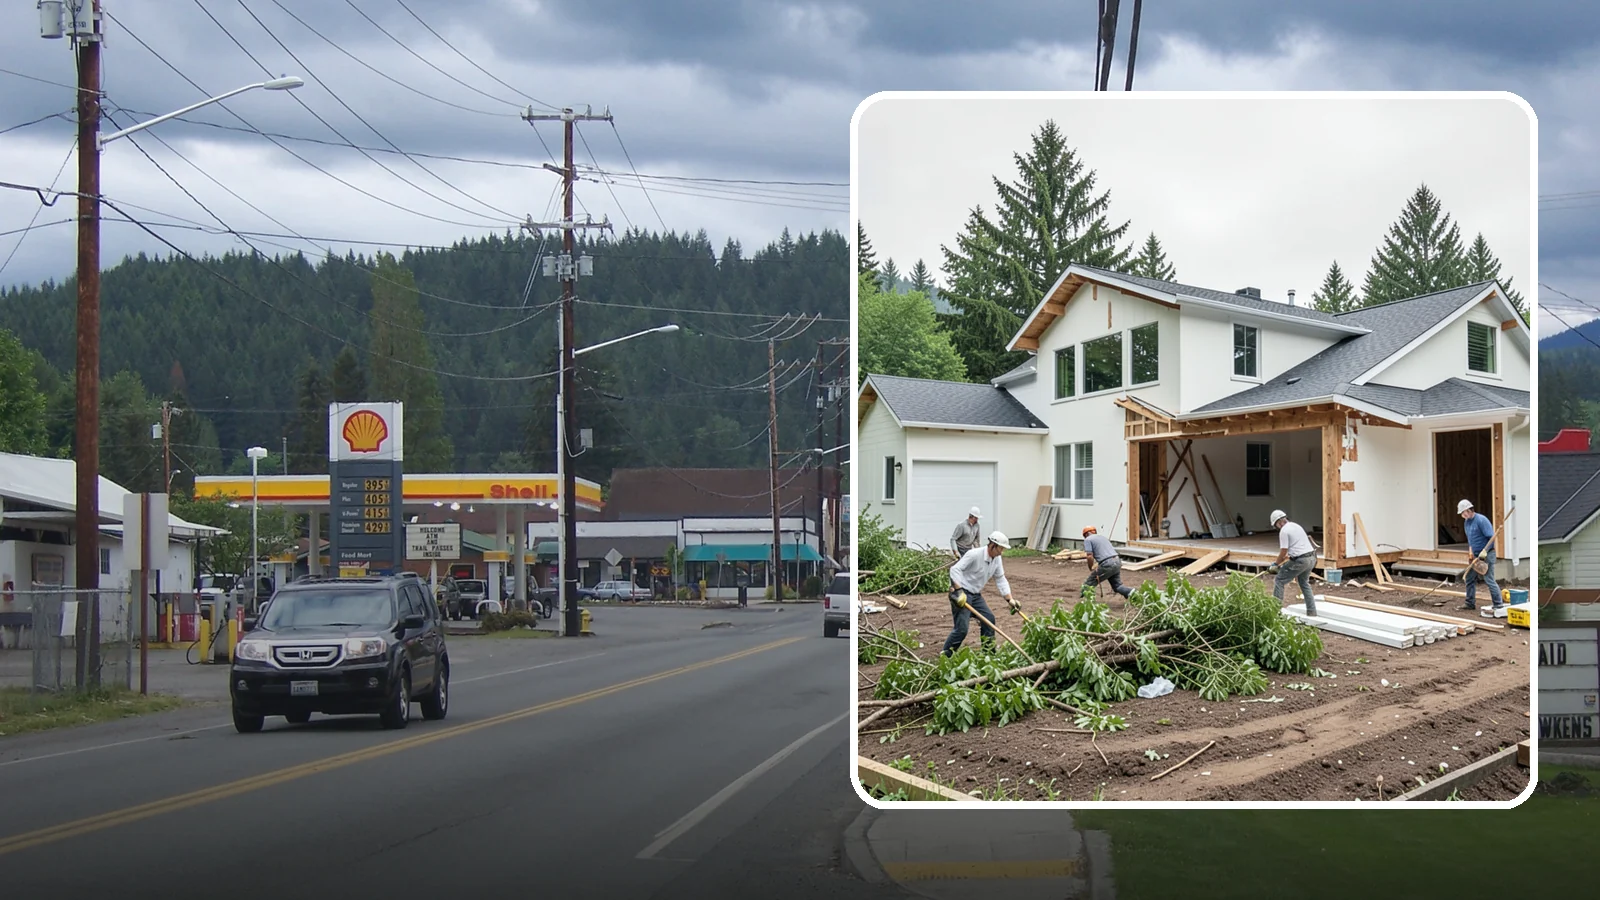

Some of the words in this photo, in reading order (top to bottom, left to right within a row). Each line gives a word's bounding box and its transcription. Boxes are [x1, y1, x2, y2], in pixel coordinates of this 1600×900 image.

[366, 480, 383, 490] 395
[490, 484, 547, 499] Shell
[366, 494, 383, 504] 405
[366, 508, 383, 518] 415
[366, 522, 383, 533] 429
